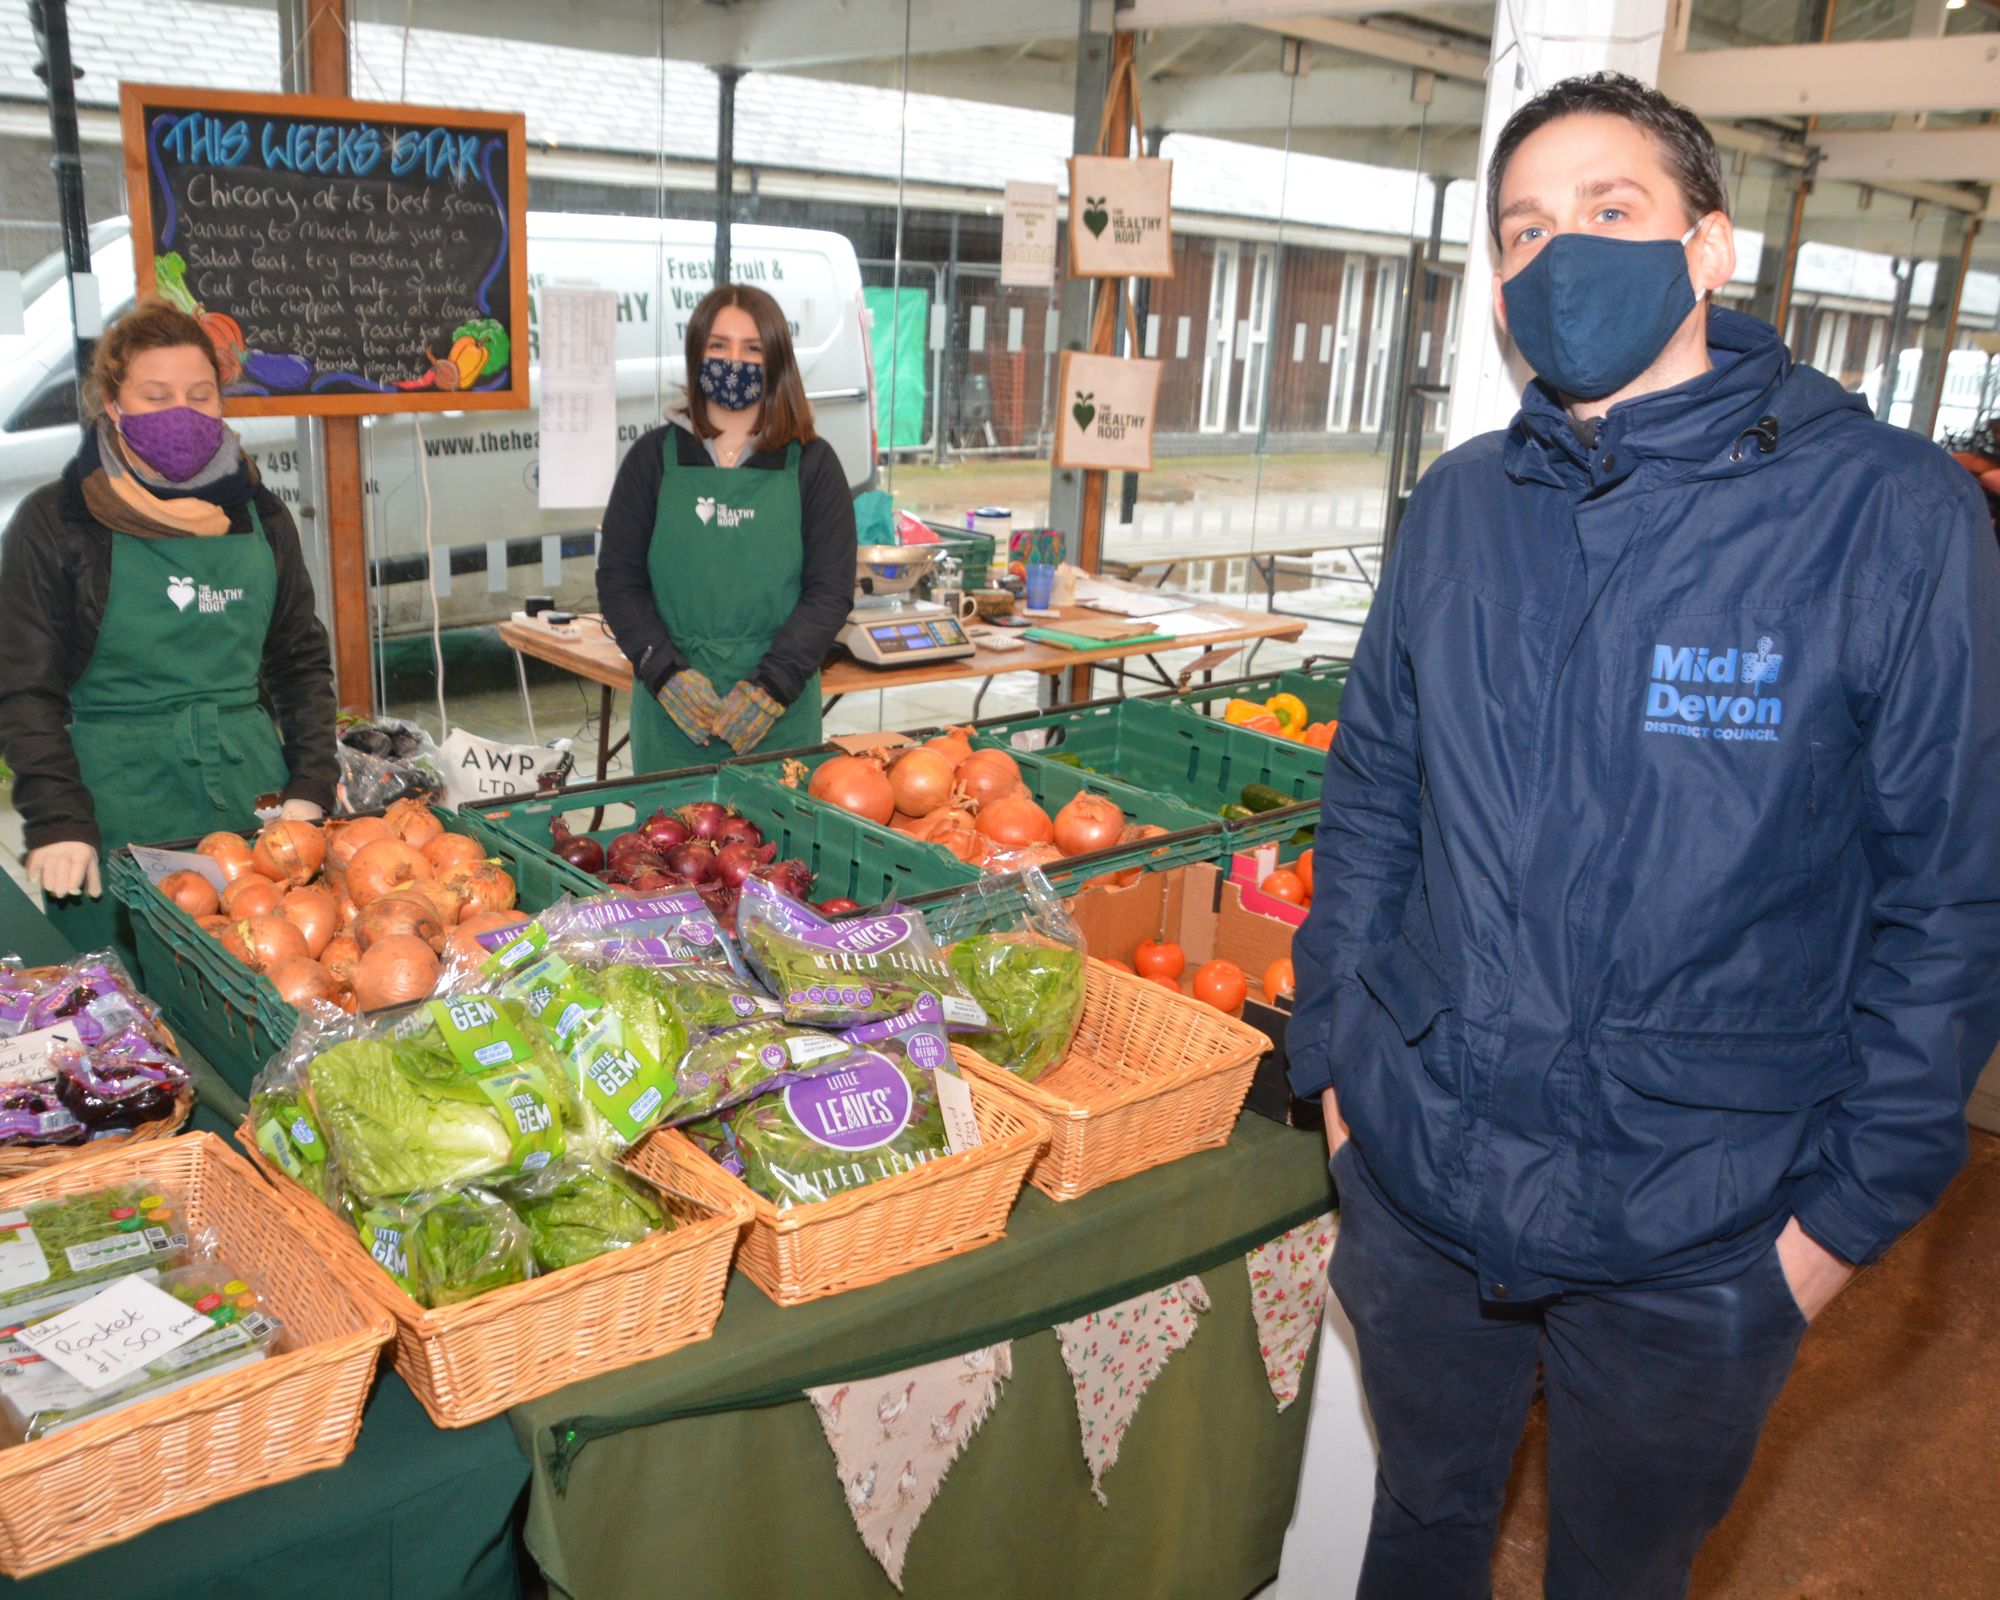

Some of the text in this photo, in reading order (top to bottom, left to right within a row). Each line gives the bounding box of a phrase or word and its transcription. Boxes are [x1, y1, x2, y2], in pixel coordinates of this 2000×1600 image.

[163, 112, 483, 182] THIS WEEK'S STAR
[313, 184, 341, 212] at
[346, 184, 375, 213] its
[386, 183, 432, 215] best
[441, 193, 494, 222] from
[178, 212, 265, 250] January
[268, 217, 290, 241] to
[299, 219, 357, 242] March
[451, 228, 469, 242] a
[1112, 216, 1161, 230] HEALTHY
[1114, 229, 1142, 243] ROOT
[188, 243, 242, 268] Salad
[306, 248, 339, 280] try
[350, 247, 424, 280] roasting
[772, 259, 784, 280] &
[198, 270, 233, 298] Cut
[322, 283, 340, 297] in
[231, 298, 271, 317] with
[280, 298, 345, 323] chopped
[1097, 425, 1126, 439] ROOT
[1098, 412, 1145, 428] HEALTHY
[717, 508, 755, 519] HEALTHY
[717, 517, 740, 527] ROOT
[198, 588, 243, 601] HEALTHY
[199, 600, 226, 612] ROOT
[1650, 644, 1739, 683] Mid
[1645, 682, 1783, 725] Devon
[1644, 720, 1778, 742] DISTRICT COUNCIL
[461, 746, 535, 776] AWP
[478, 778, 516, 796] LTD
[647, 899, 688, 915] PURE
[813, 951, 951, 978] MIXED LEAVES
[449, 999, 498, 1032] GEM
[884, 1011, 927, 1033] PURE
[914, 1037, 935, 1047] WASH
[914, 1046, 939, 1058] BEFORE
[586, 1051, 615, 1080] LITTLE
[596, 1048, 643, 1097] GEM
[922, 1057, 937, 1068] USE
[825, 1070, 861, 1091] LITTLE
[506, 1093, 536, 1110] LITTLE
[815, 1087, 895, 1136] LEAVES
[513, 1102, 553, 1136] GEM
[793, 1144, 954, 1198] MIXED LEAVES
[371, 1239, 409, 1279] GEM
[55, 1308, 144, 1355] Rocket
[84, 1327, 161, 1374] £1.50
